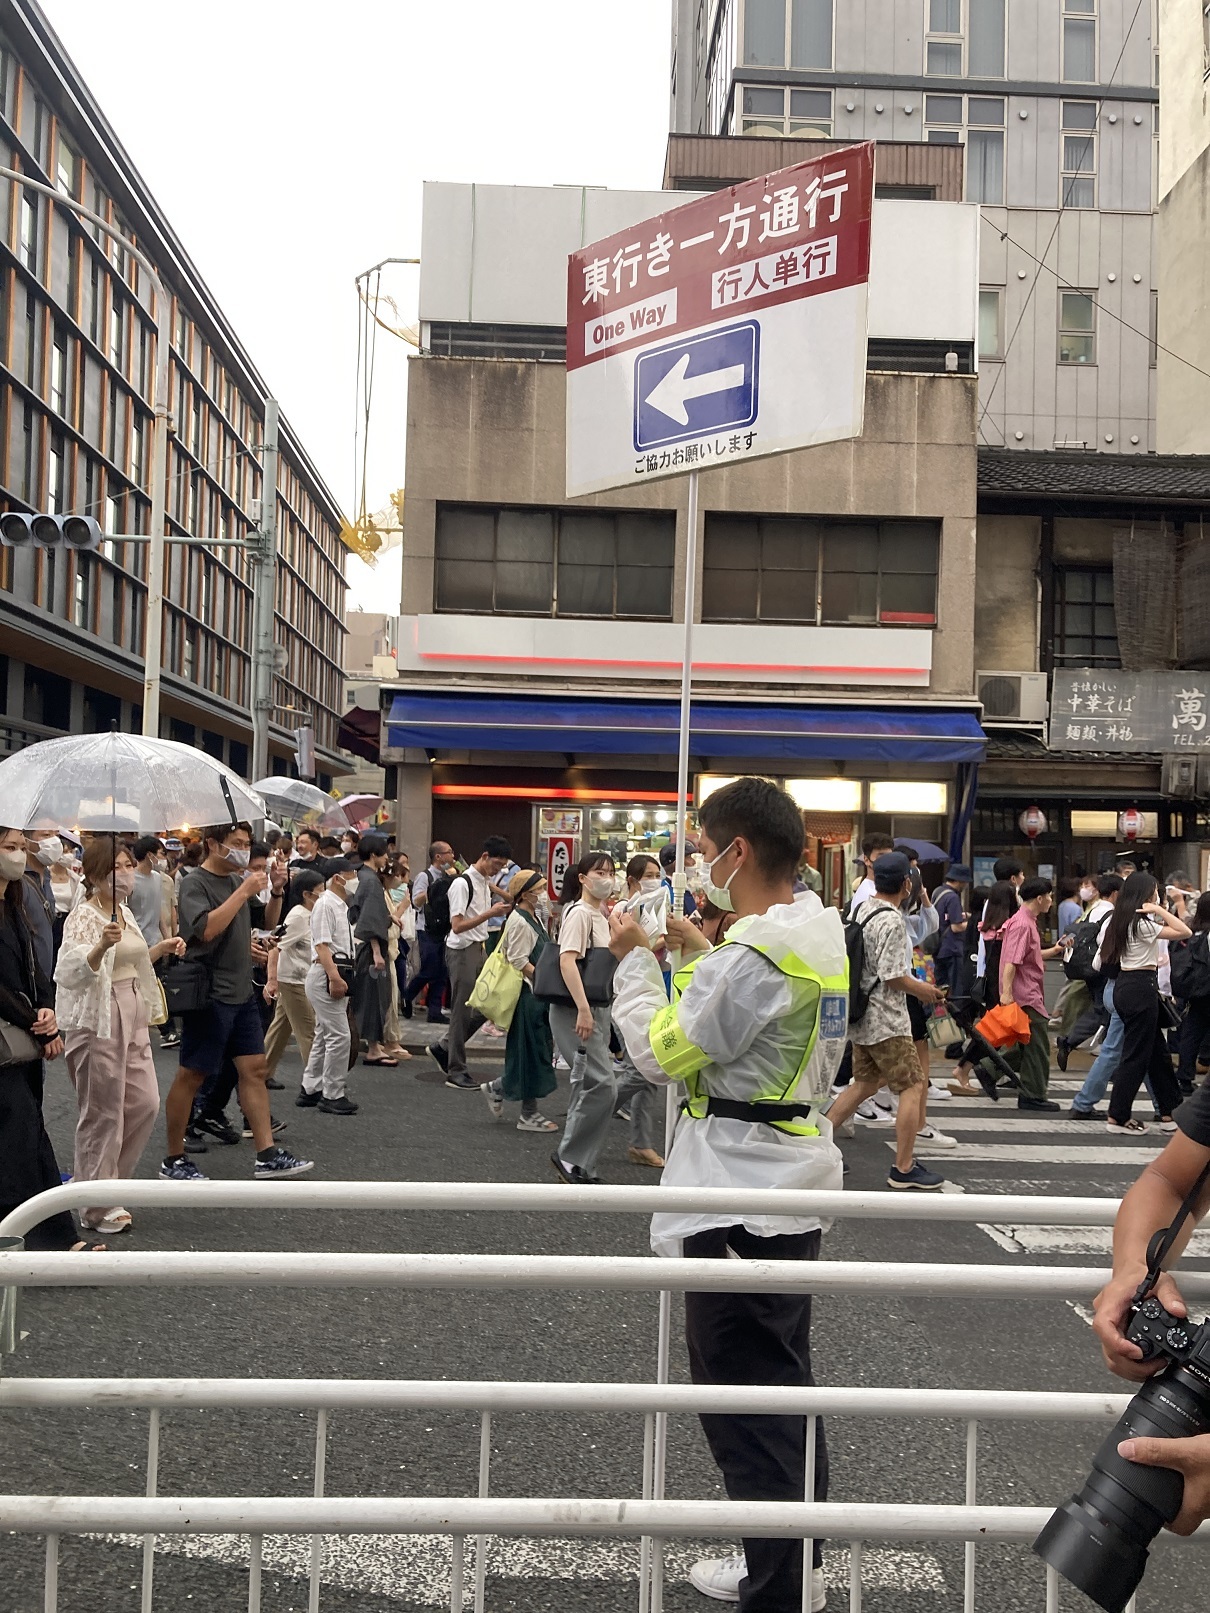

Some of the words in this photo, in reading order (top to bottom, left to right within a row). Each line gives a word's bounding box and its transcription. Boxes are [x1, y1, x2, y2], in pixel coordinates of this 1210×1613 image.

[582, 169, 849, 306] 東行き一方通行
[592, 320, 626, 345] One
[629, 303, 668, 331] Way
[634, 430, 758, 474] ご協力お願いします
[1067, 693, 1137, 713] 中華そば
[1171, 687, 1207, 732] 萬
[555, 846, 568, 891] たばこ
